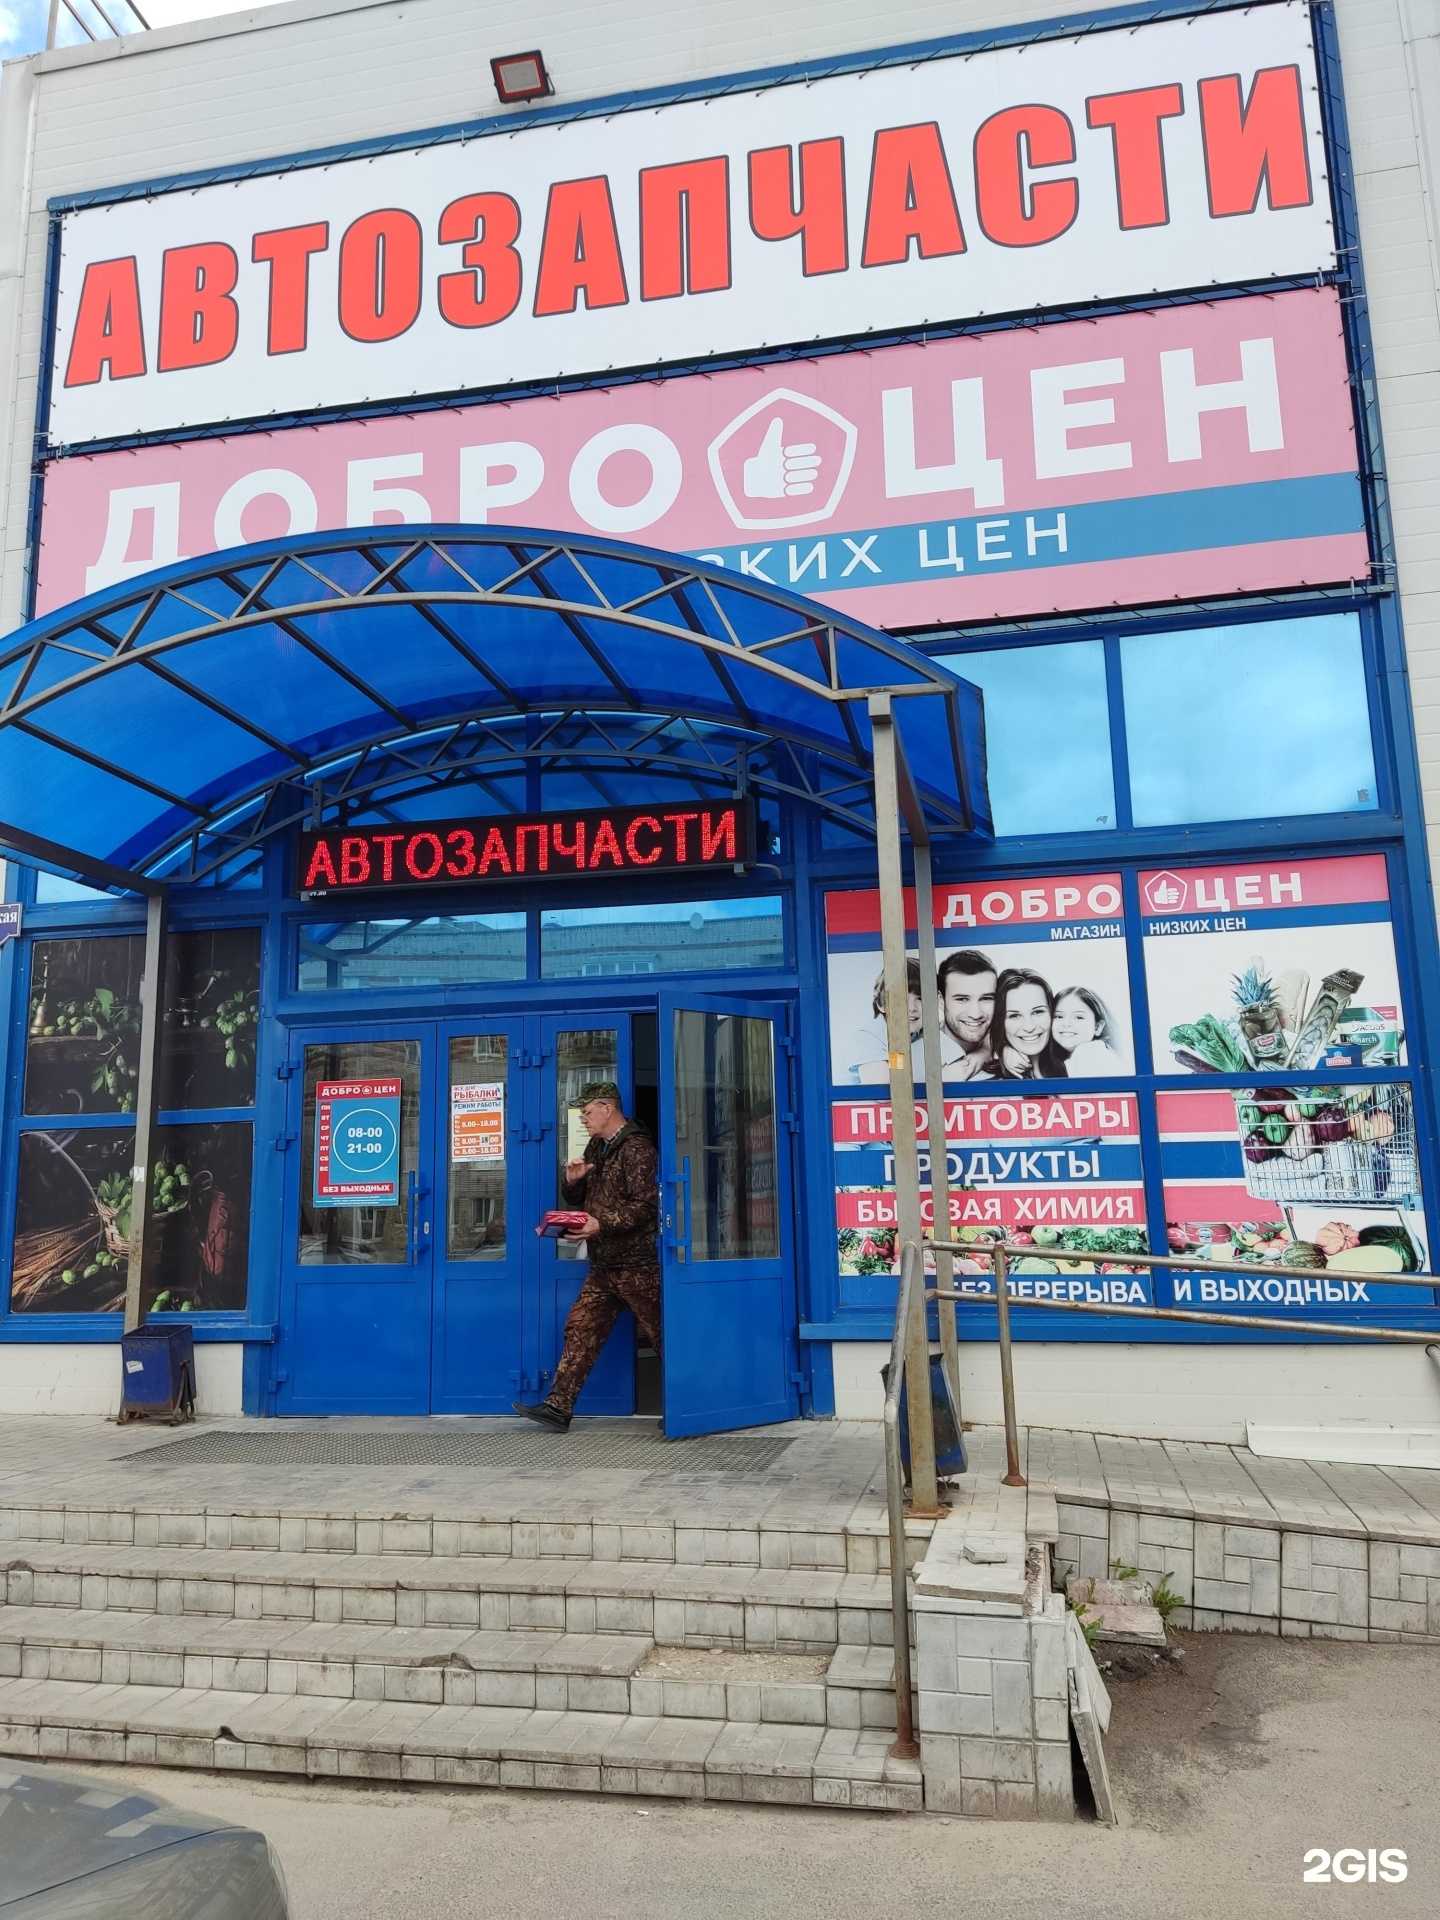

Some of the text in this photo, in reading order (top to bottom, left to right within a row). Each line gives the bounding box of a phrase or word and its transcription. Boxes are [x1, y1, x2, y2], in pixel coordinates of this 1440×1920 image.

[64, 64, 1315, 387] АВТОЗАПЧАСТИ
[85, 337, 1285, 596] ДОБРО ЦЕН
[918, 512, 1068, 572] ЦЕН
[304, 809, 726, 887] АВТОЗАПЧАСТИ
[942, 872, 1303, 929] ДОБРО ЦЕН
[1050, 916, 1247, 941] МАГАЗИН НИЗКИХ ЦЕН
[322, 1085, 396, 1096] ДОБРО ЦЕН
[454, 1089, 498, 1099] РЫБАЛКИ
[347, 1127, 383, 1138] 08-00
[346, 1143, 382, 1154] 21-00
[340, 1184, 390, 1192] ВЫХОДНЫХ
[857, 1196, 1135, 1222] БЫОВАЯ ХИМИЯ
[954, 1281, 992, 1293] ЕЗ
[1173, 1280, 1192, 1301] И
[1200, 1279, 1370, 1305] ВЫХОДНЫХ
